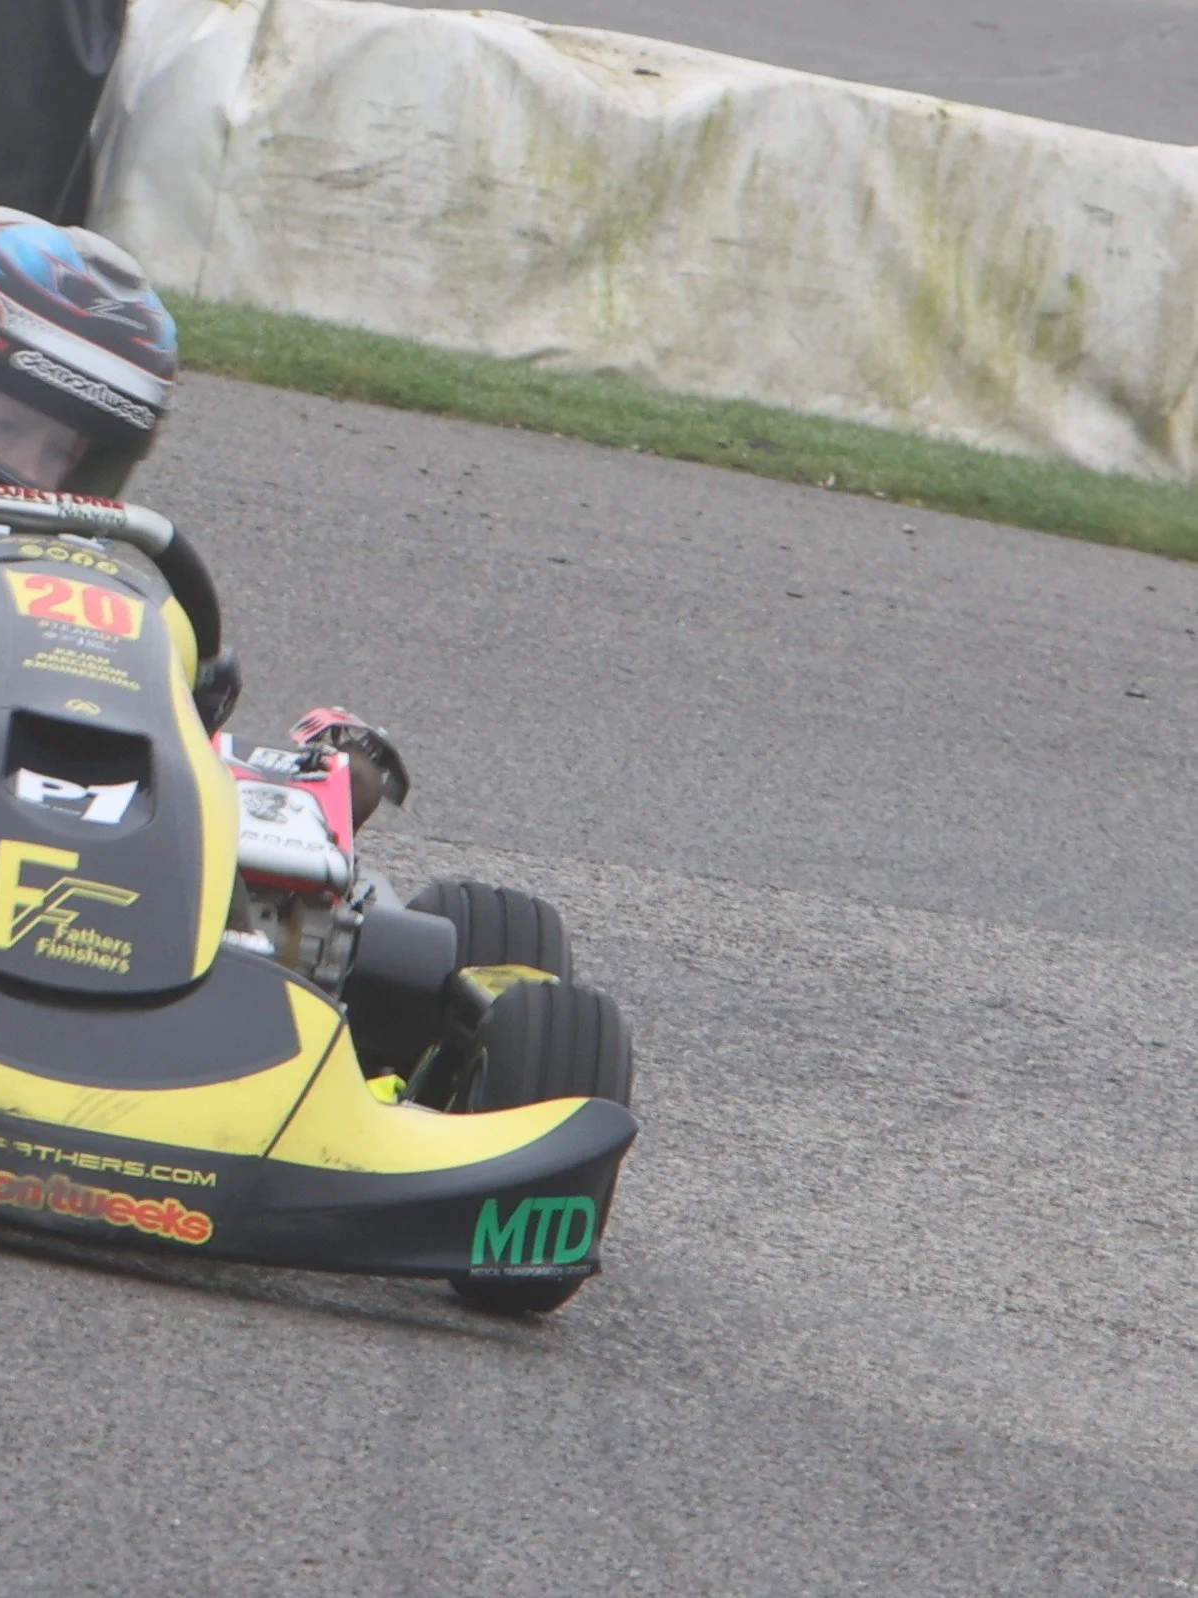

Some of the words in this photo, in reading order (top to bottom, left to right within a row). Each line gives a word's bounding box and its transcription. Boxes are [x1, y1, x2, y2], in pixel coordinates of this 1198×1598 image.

[24, 574, 134, 634] 20
[16, 768, 140, 825] P1
[34, 936, 131, 975] Finishers
[52, 922, 133, 957] Fathers
[470, 1195, 597, 1266] MTD
